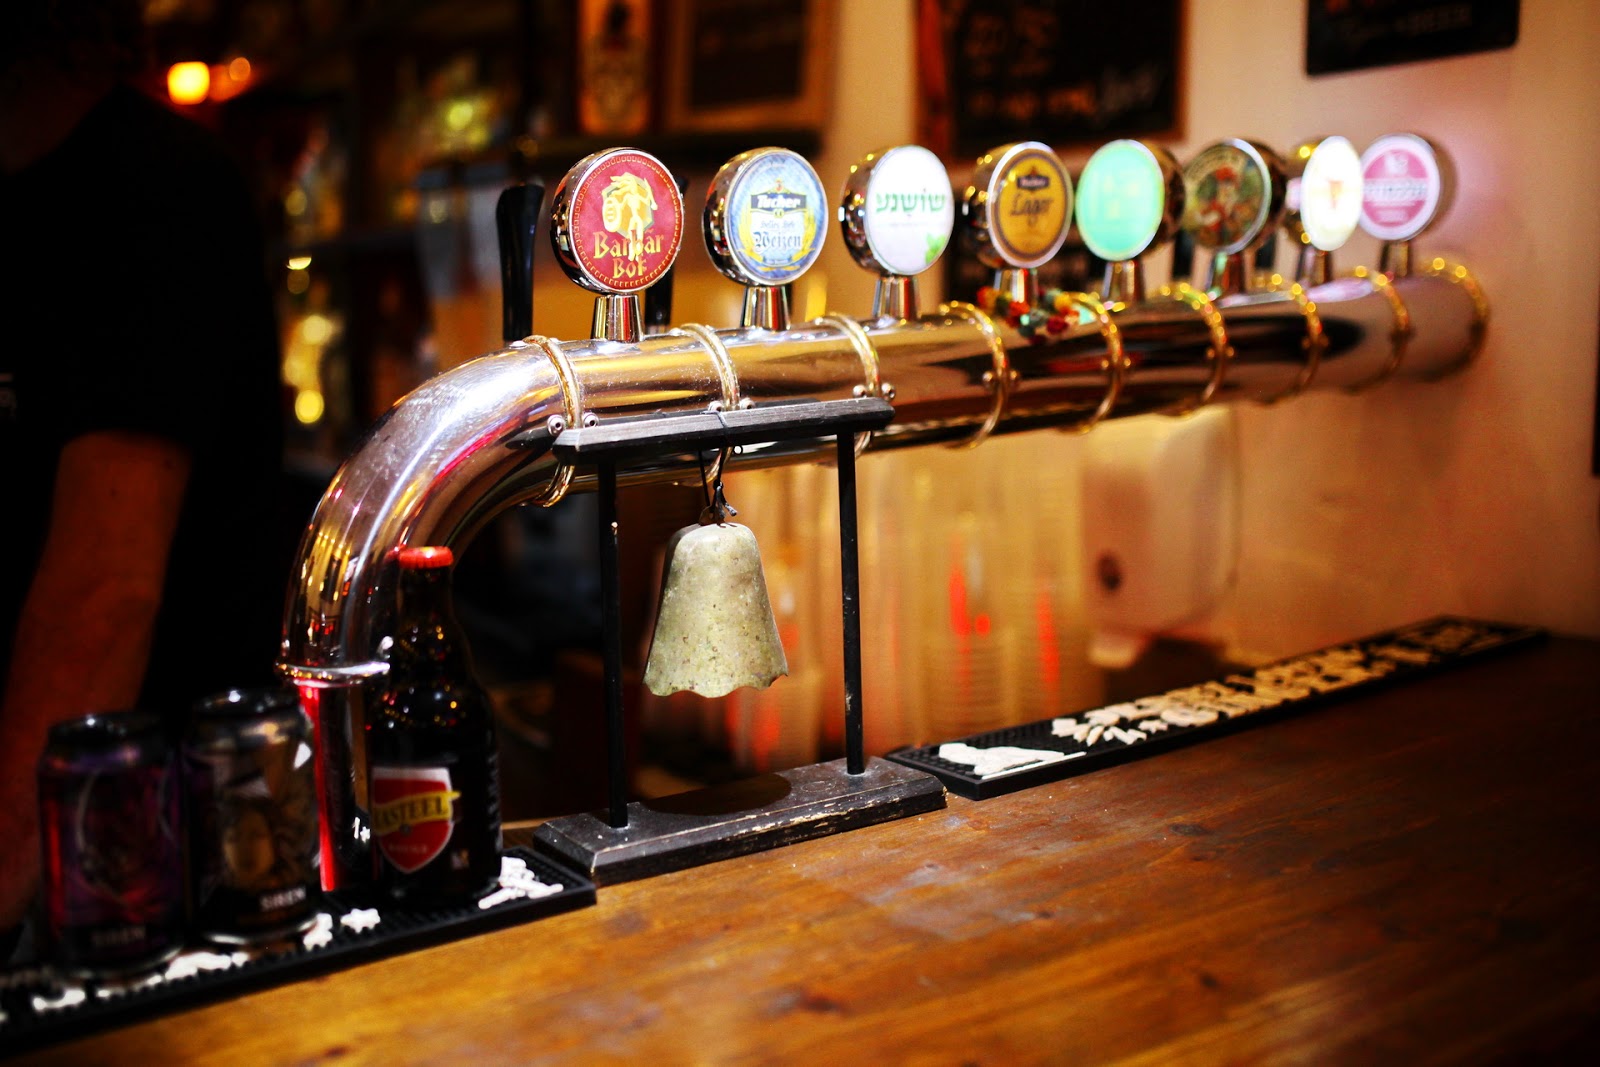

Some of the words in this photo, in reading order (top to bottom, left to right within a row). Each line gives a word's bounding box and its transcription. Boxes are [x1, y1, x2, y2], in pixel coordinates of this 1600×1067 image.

[757, 194, 801, 209] Tucher
[753, 231, 801, 252] Weizen
[612, 254, 648, 279] Bok
